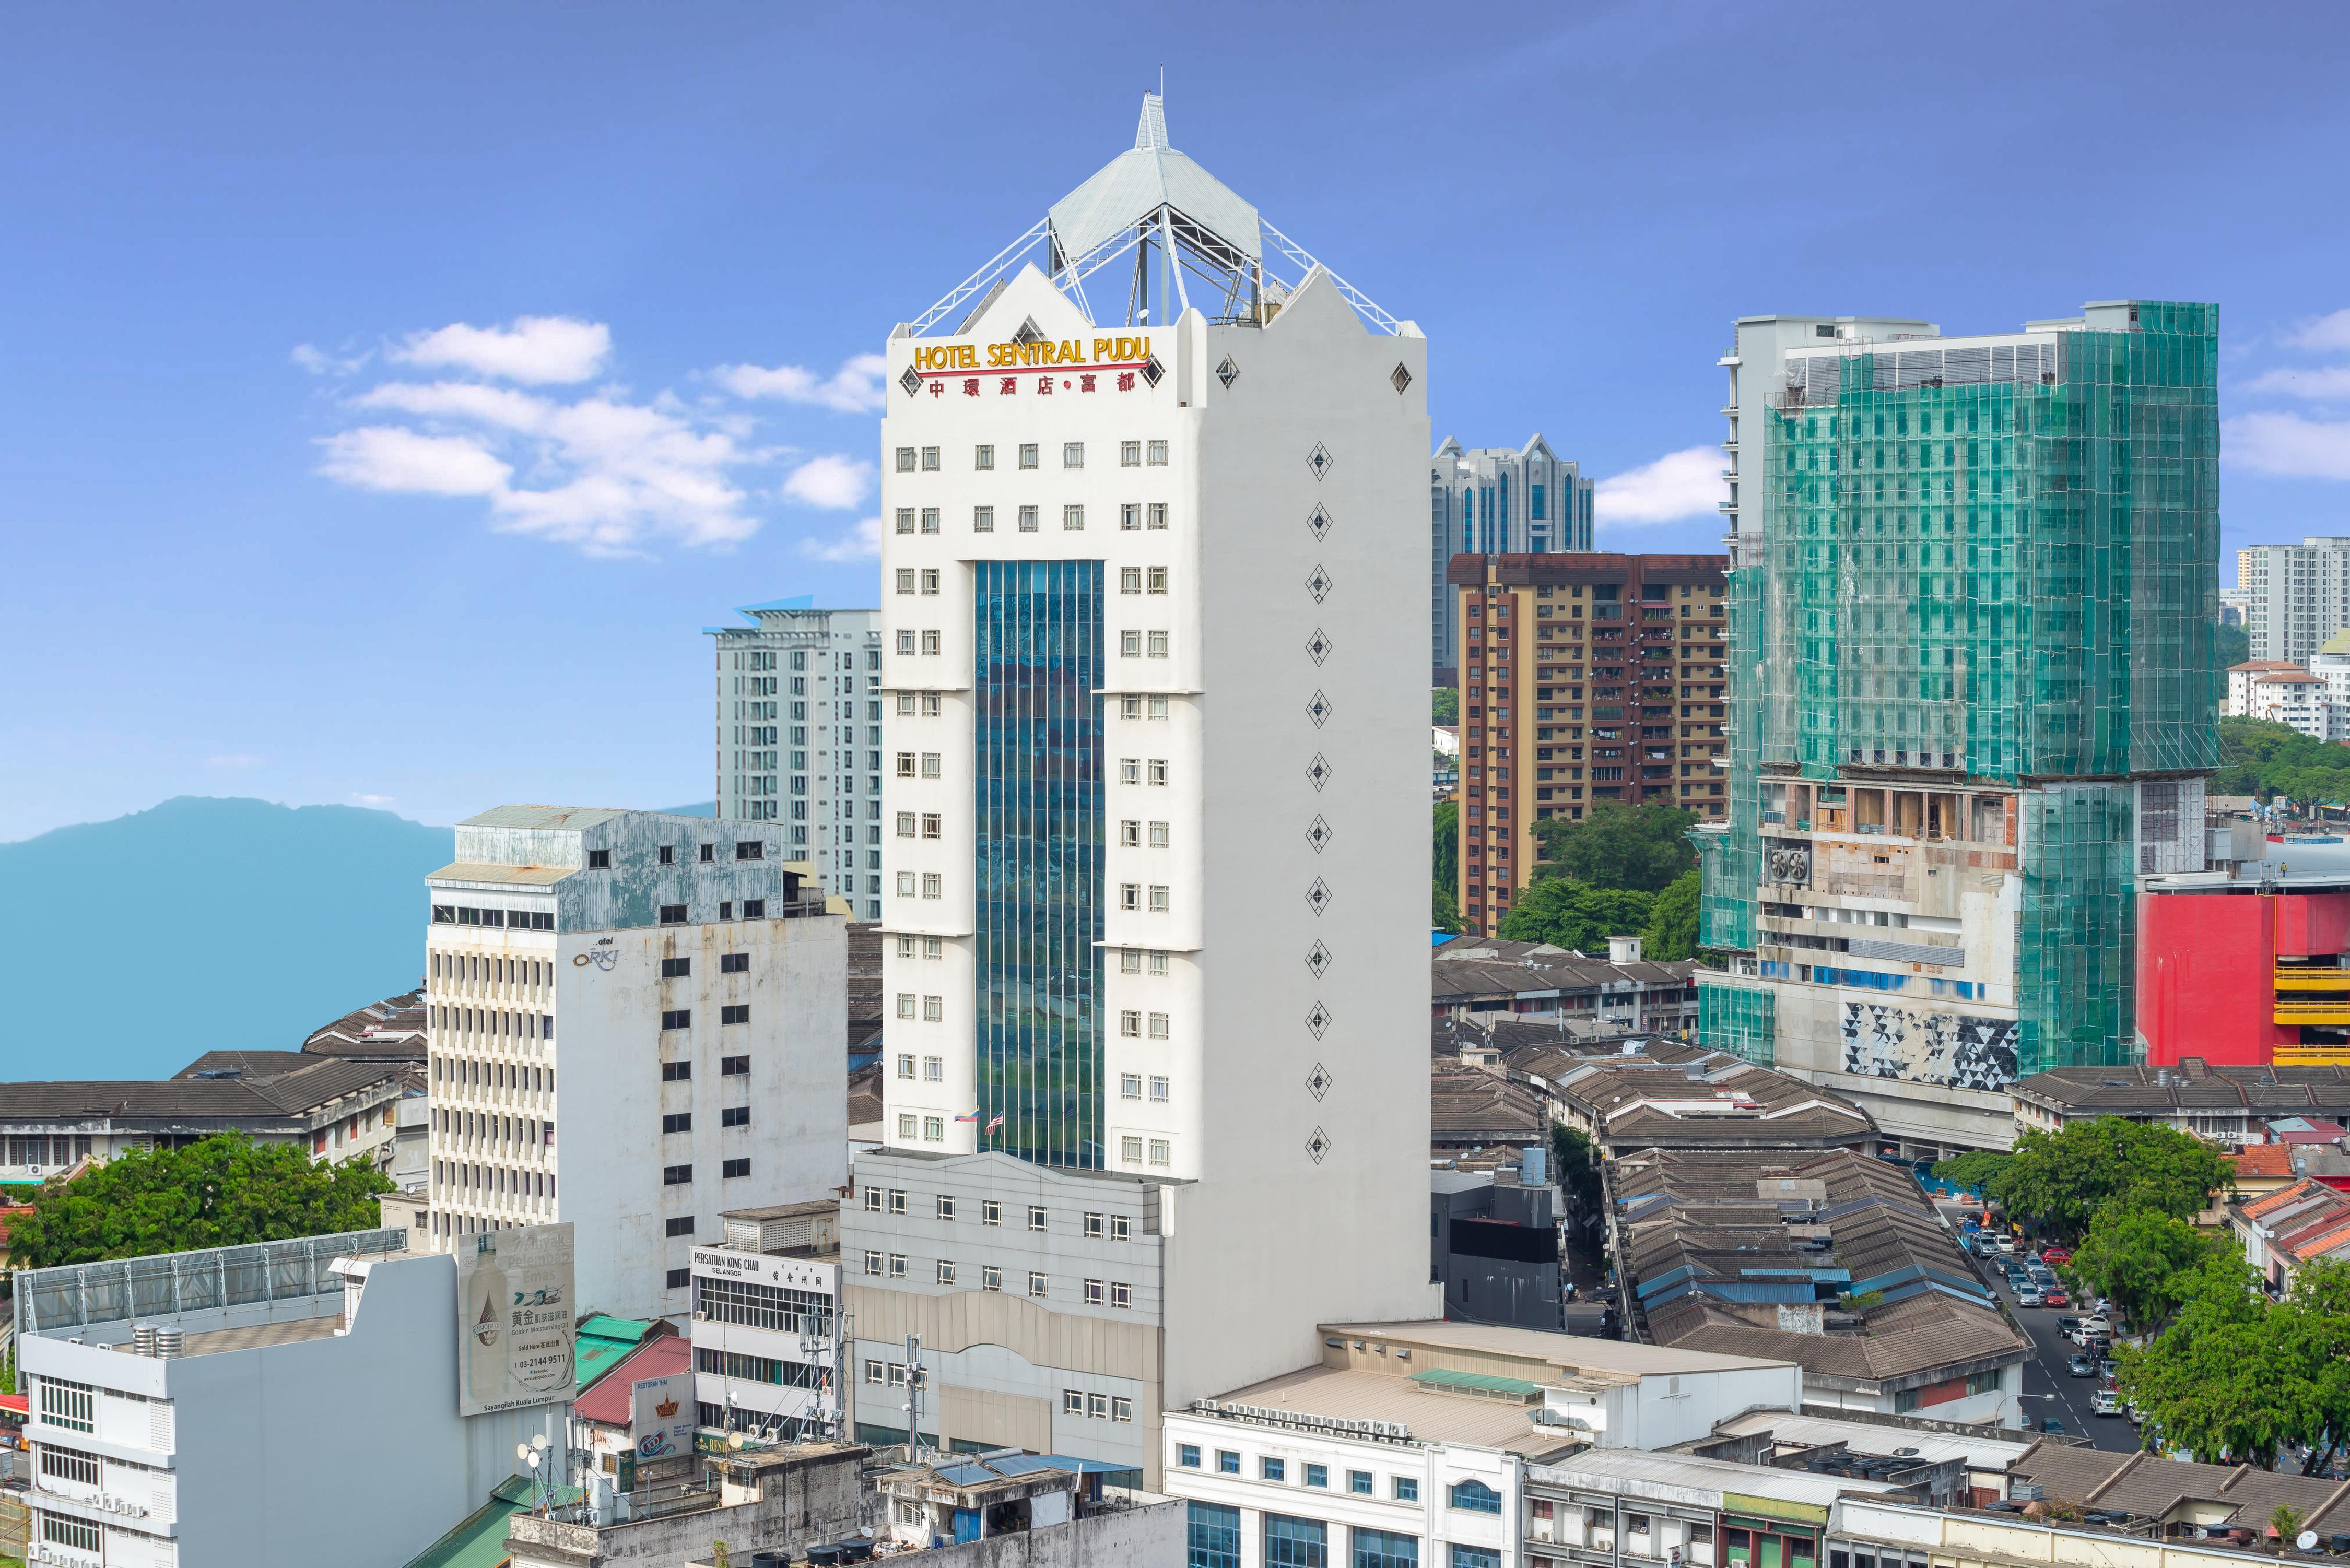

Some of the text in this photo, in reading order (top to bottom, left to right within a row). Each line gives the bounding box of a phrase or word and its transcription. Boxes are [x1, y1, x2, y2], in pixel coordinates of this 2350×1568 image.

[915, 337, 1149, 370] HOTEL SENTRAL PUDU
[596, 937, 613, 945] otel
[573, 950, 619, 971] ORKI
[695, 1252, 759, 1271] PERSATUAN KONG CHAU
[523, 1270, 555, 1283] Emas
[712, 1267, 742, 1277] SELANGOR
[476, 1323, 494, 1331] JOJOBA
[530, 1324, 560, 1333] Moisturising
[540, 1339, 560, 1348] 在此出售
[520, 1354, 565, 1368] 03-2144 9511
[638, 1380, 658, 1389] RESTORAN
[484, 1400, 514, 1411] Sayangilah
[516, 1398, 532, 1406] Kuala
[647, 1437, 659, 1451] 100
